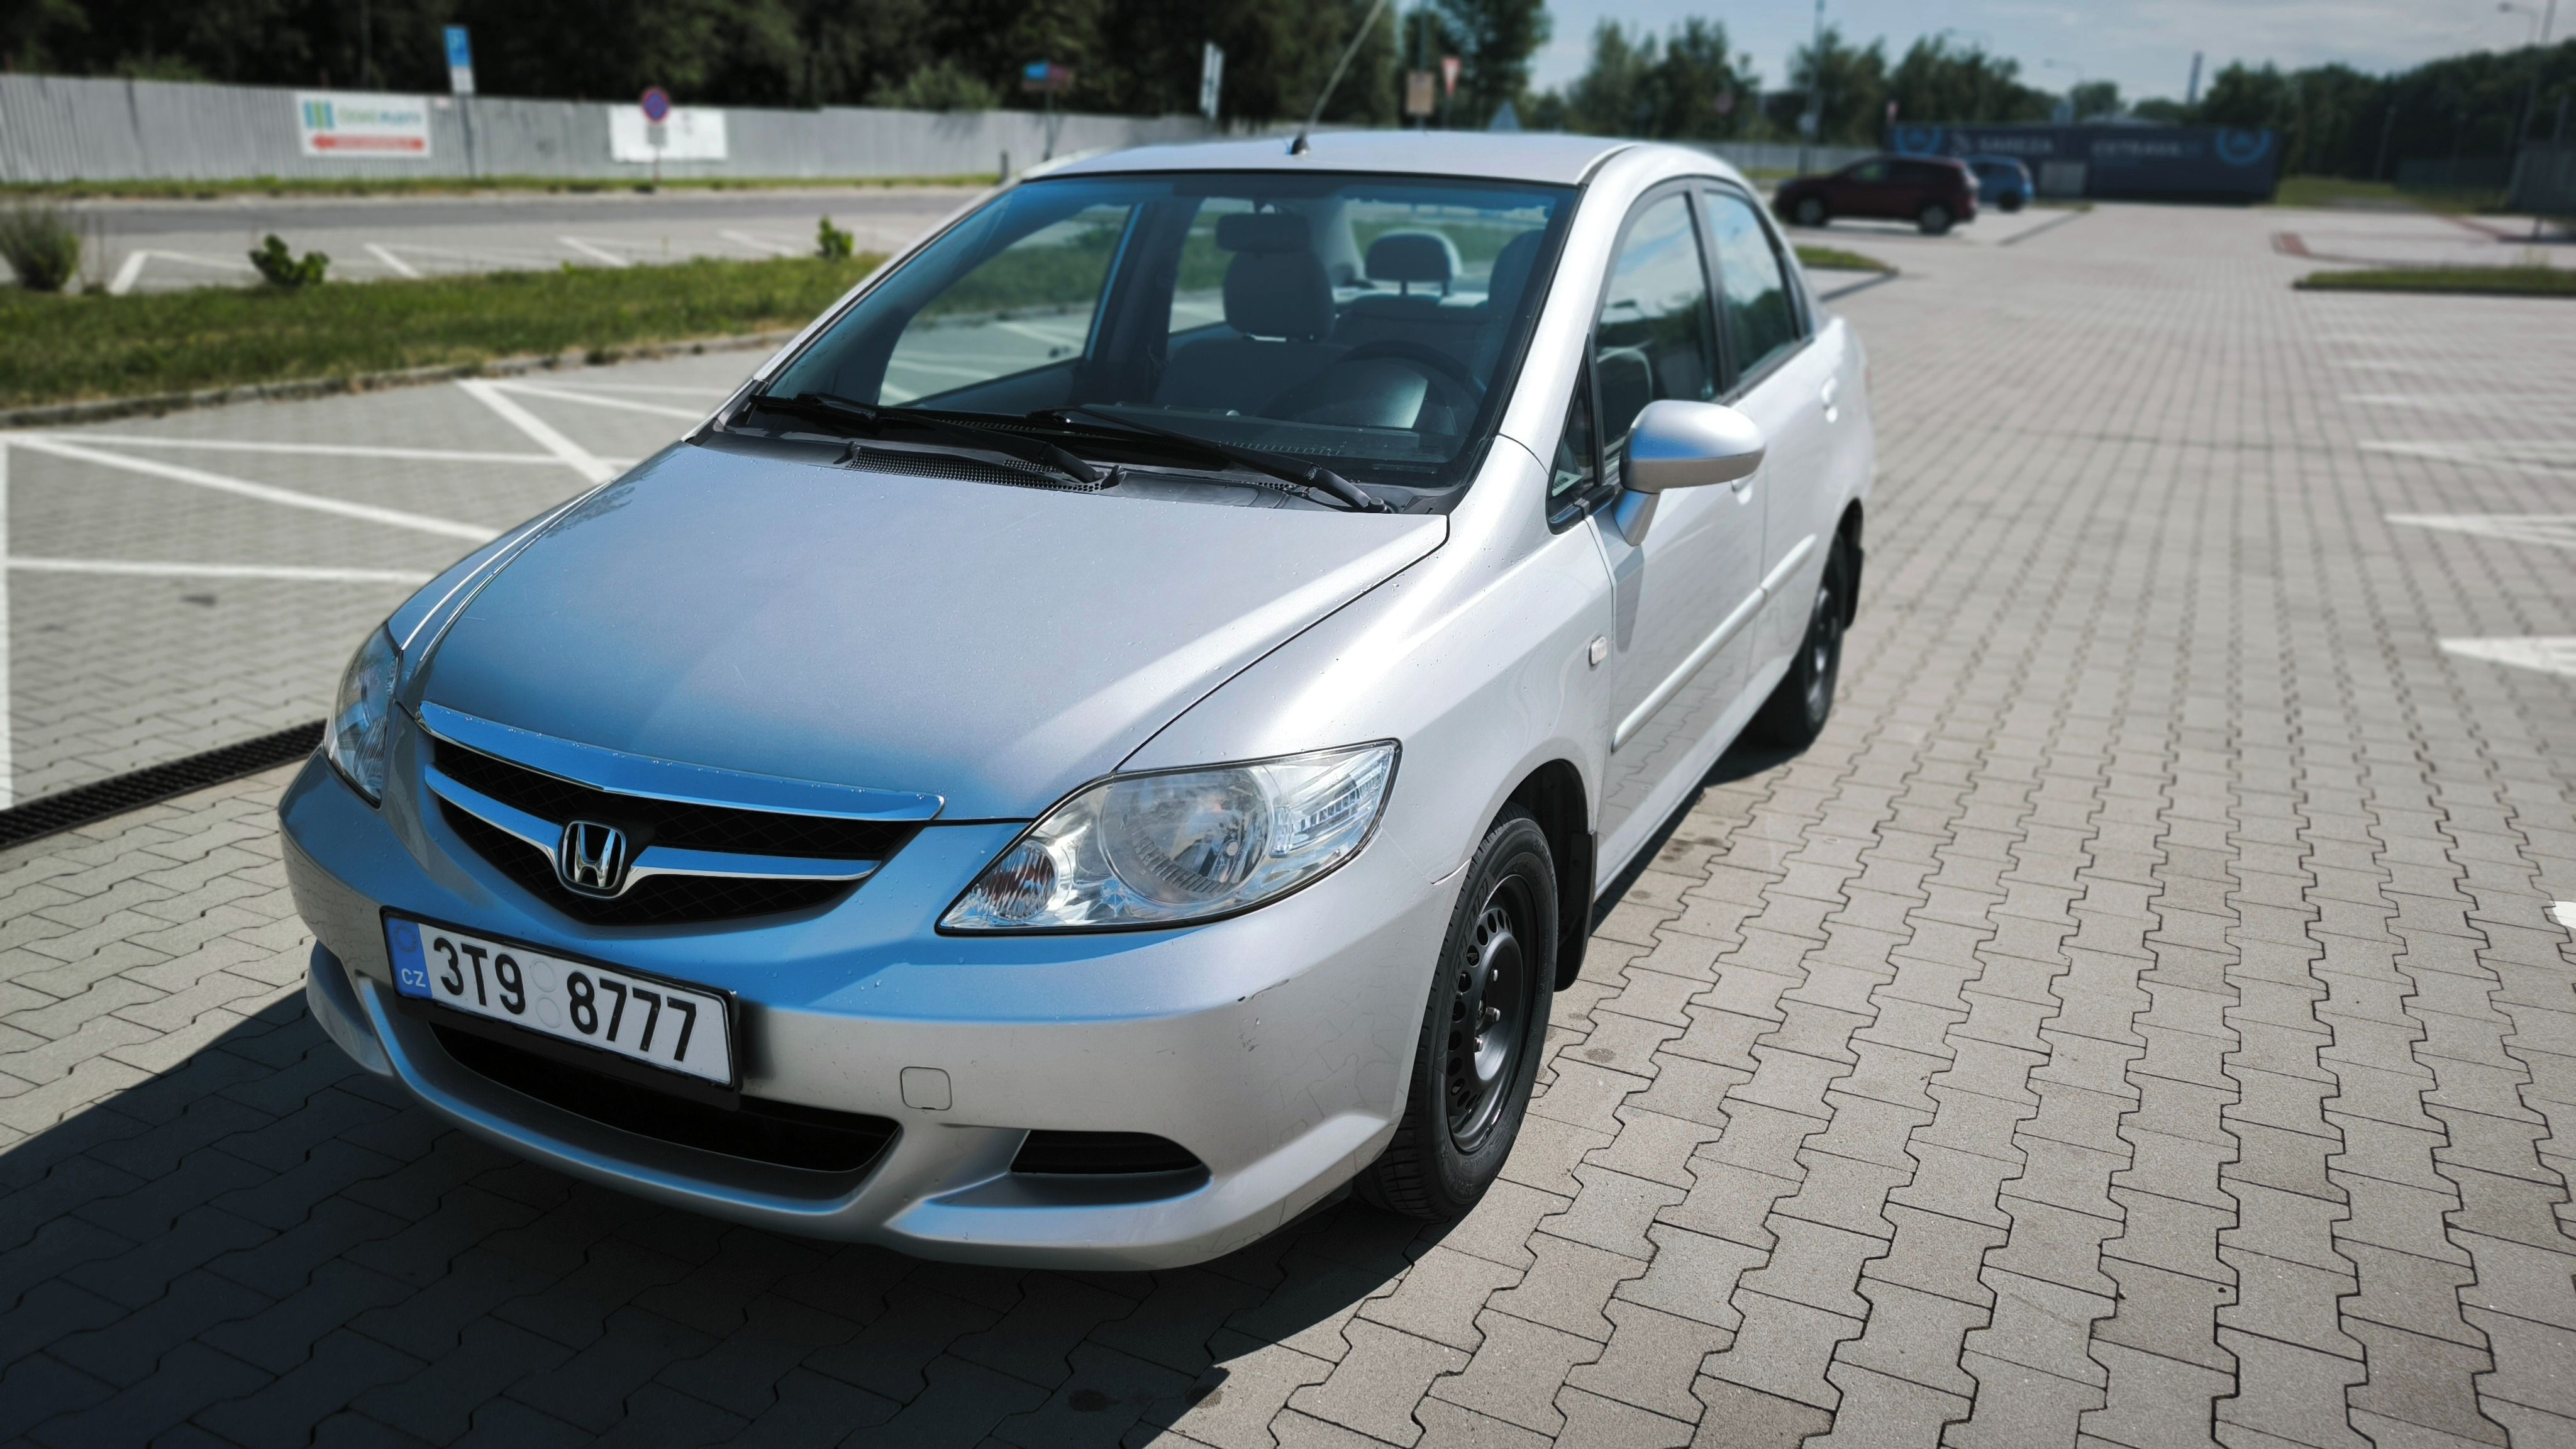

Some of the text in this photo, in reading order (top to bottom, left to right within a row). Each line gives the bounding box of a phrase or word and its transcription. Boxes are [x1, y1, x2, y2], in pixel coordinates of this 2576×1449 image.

[401, 968, 426, 988] CZ
[433, 936, 697, 1062] 3T9 8777
